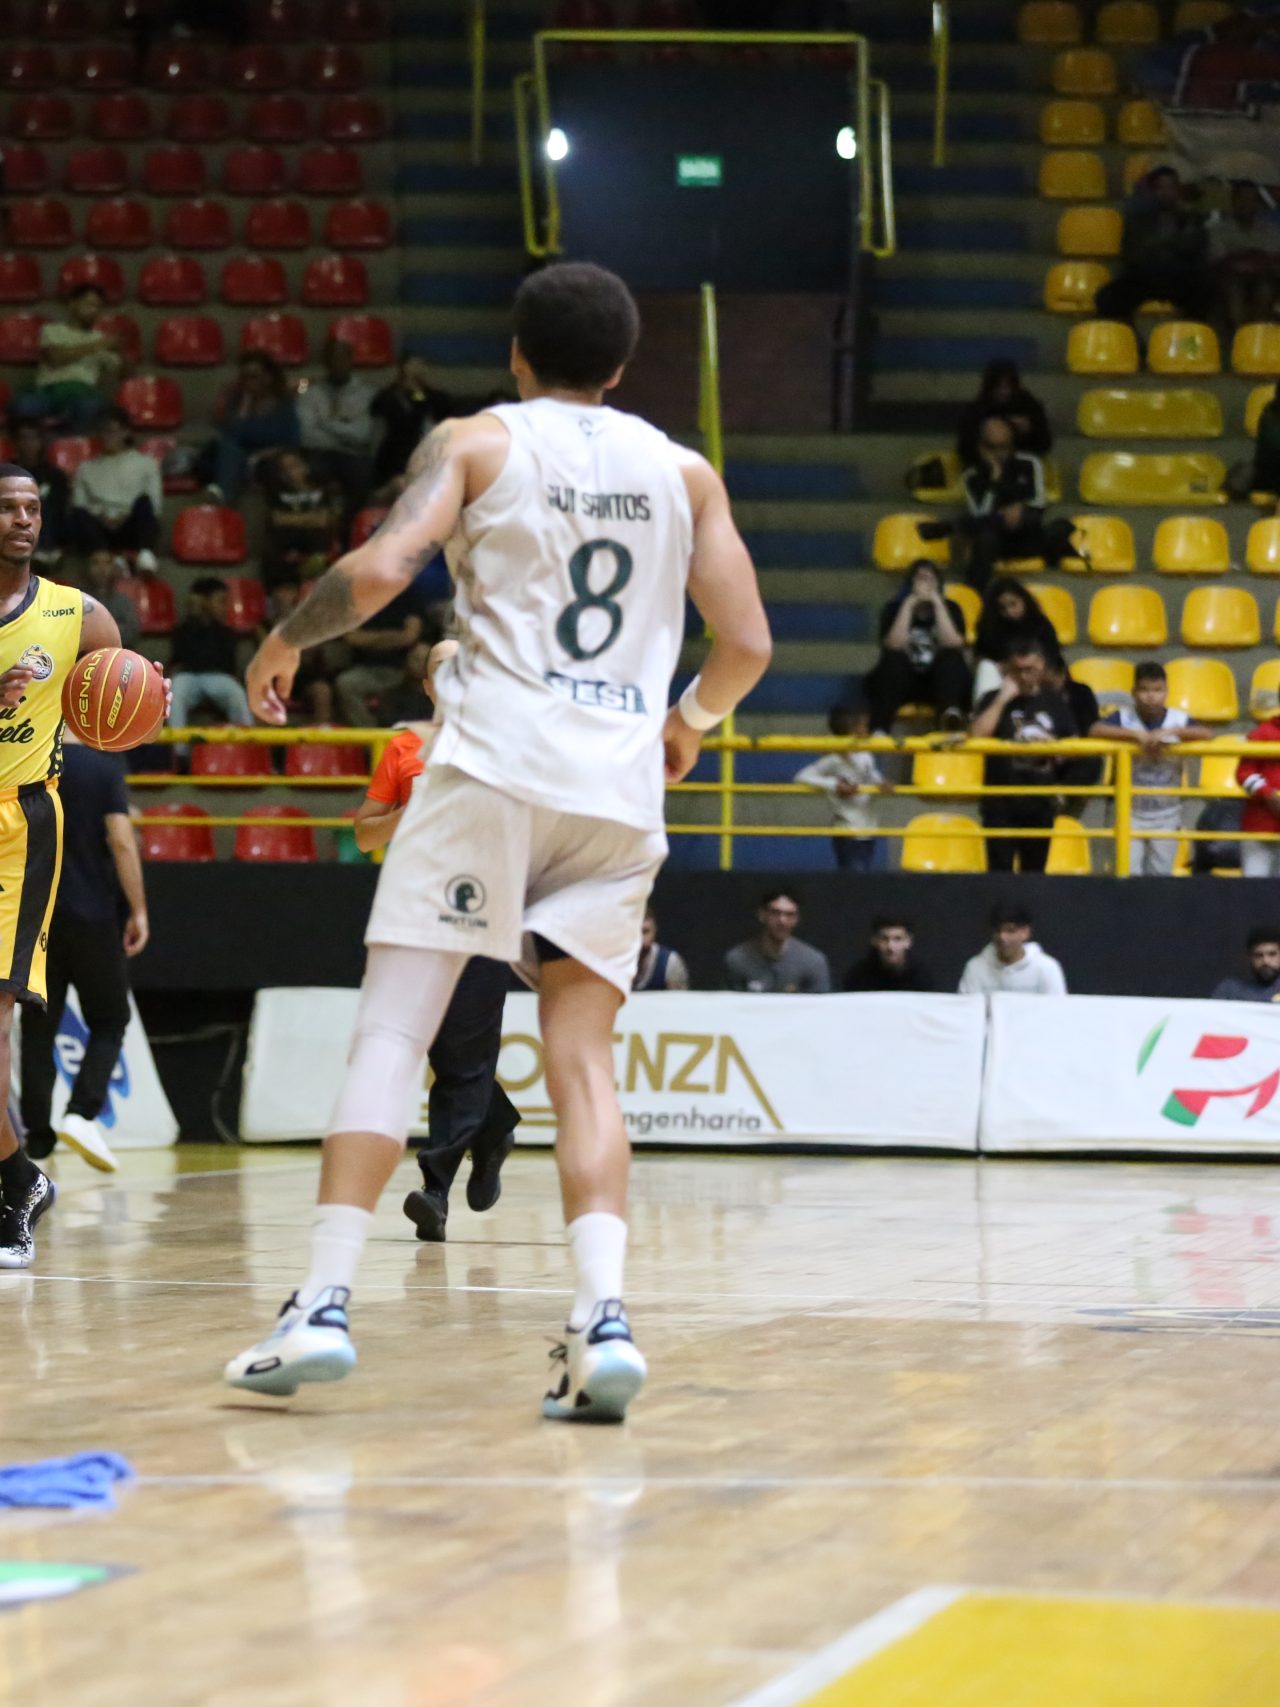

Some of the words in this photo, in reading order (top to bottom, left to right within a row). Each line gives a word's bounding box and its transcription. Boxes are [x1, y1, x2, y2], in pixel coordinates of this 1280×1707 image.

[582, 491, 650, 521] SANTOS
[51, 606, 76, 618] UPIX
[556, 538, 633, 661] 8
[622, 1105, 762, 1134] ngenharia
